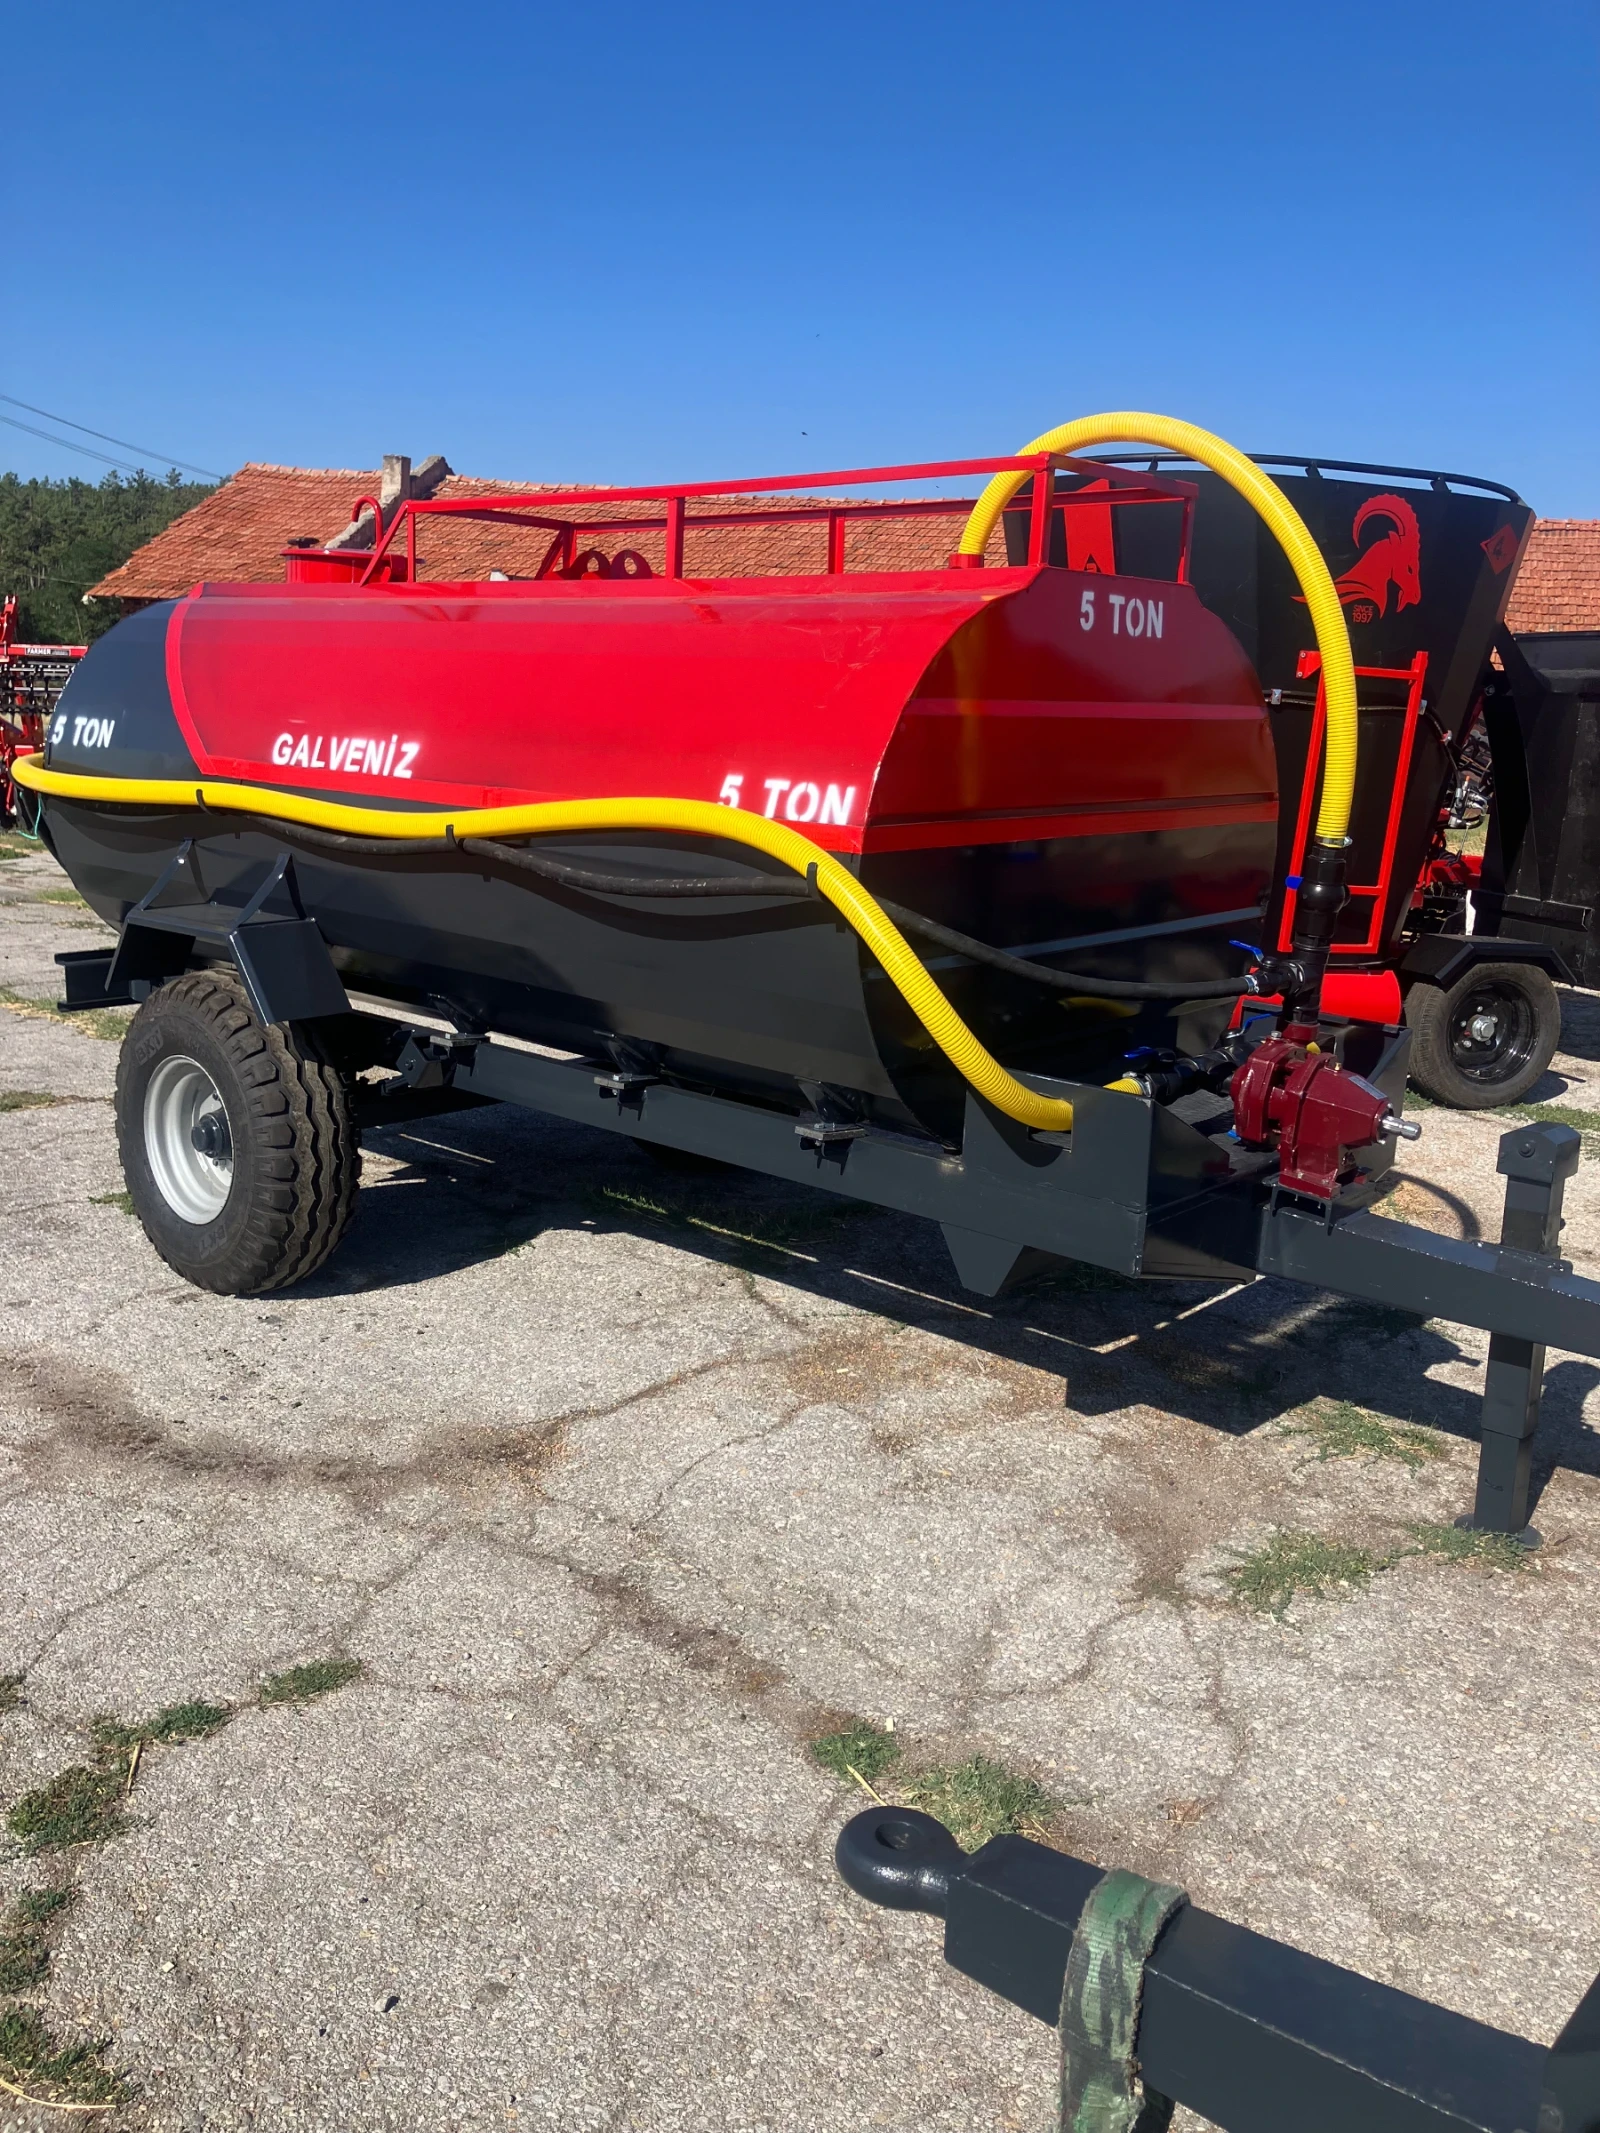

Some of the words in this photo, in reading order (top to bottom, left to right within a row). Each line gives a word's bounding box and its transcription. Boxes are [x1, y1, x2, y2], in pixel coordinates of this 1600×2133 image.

[1080, 591, 1095, 631] 5
[1109, 594, 1163, 639] TON
[1352, 612, 1373, 624] 1997
[1353, 604, 1374, 613] SINCE
[27, 647, 52, 655] FARMER
[51, 715, 67, 745] 5
[73, 716, 115, 748] TON
[272, 732, 420, 779] GALVENİZ
[717, 774, 744, 809] 5
[763, 779, 856, 826] TON
